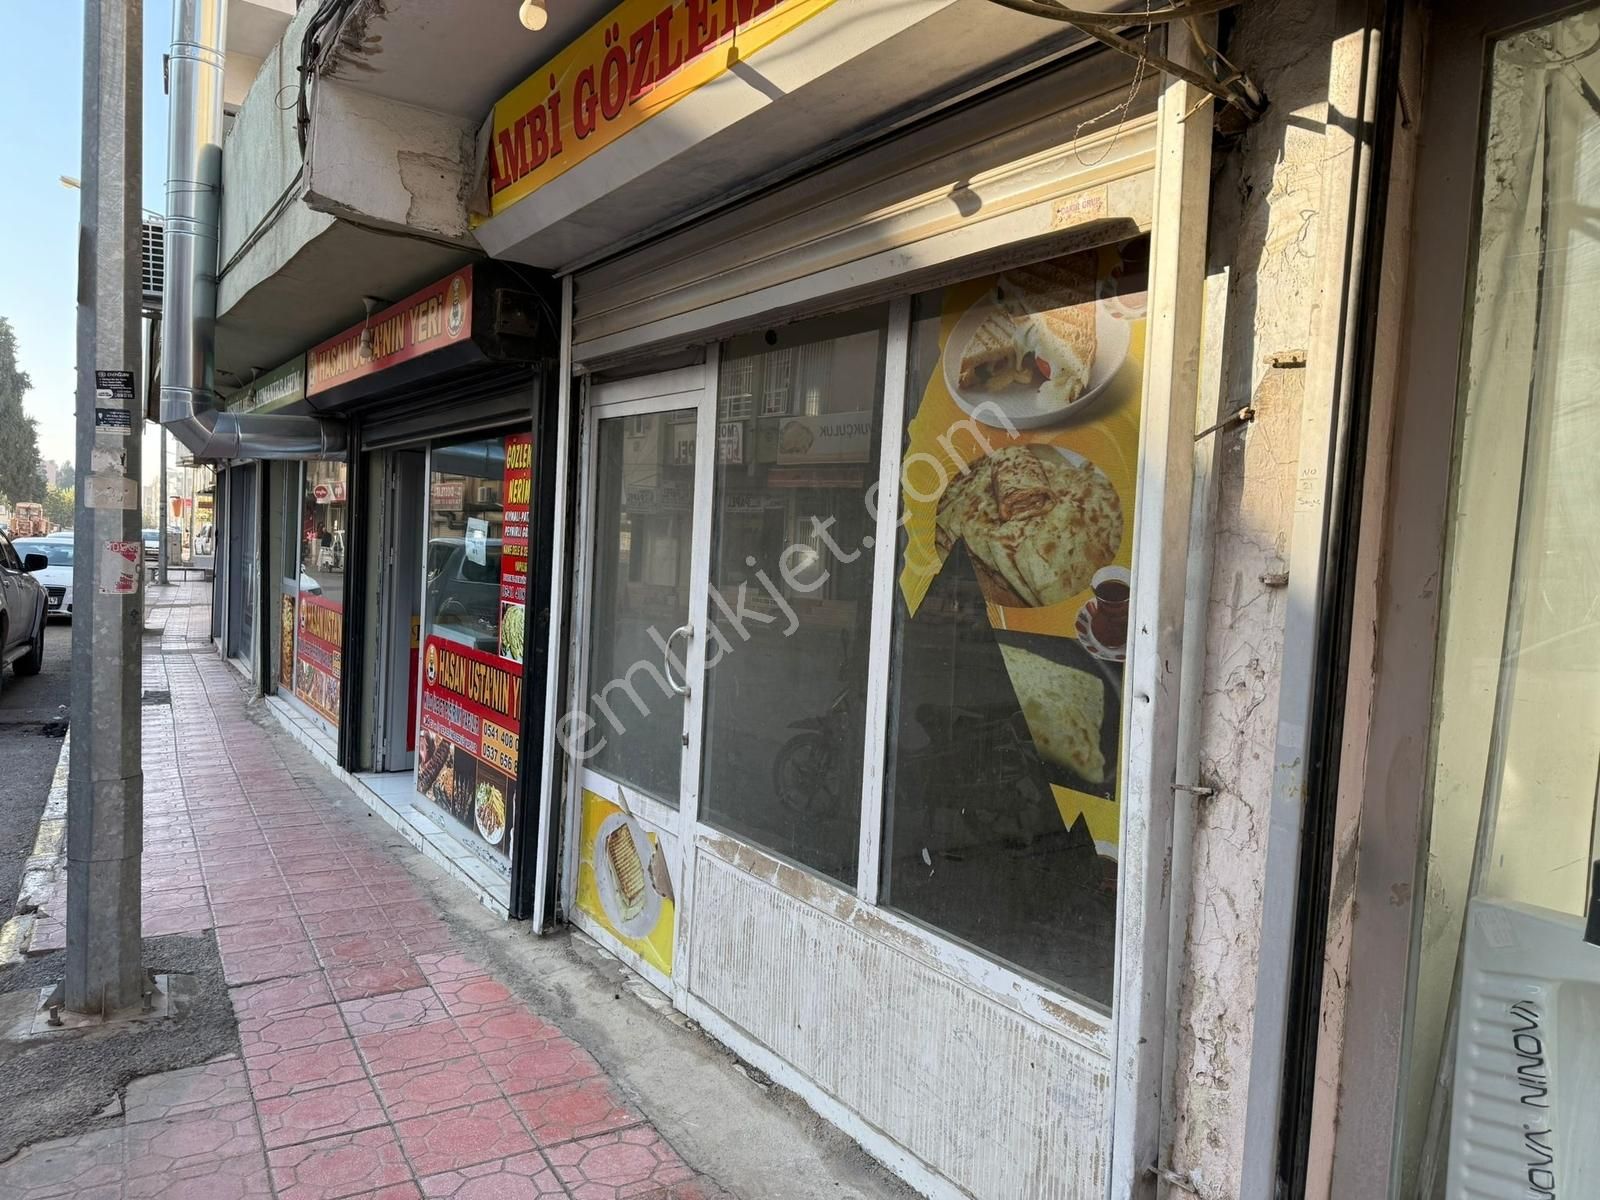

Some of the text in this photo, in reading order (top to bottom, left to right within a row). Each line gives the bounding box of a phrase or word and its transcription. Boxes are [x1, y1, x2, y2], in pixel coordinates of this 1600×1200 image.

[319, 340, 350, 380] HASAN
[438, 648, 467, 697] HASAN
[468, 658, 510, 718] USTA'NIN
[483, 722, 499, 741] 0541
[501, 732, 513, 749] 408
[483, 743, 498, 762] 0537
[500, 752, 512, 770] 656
